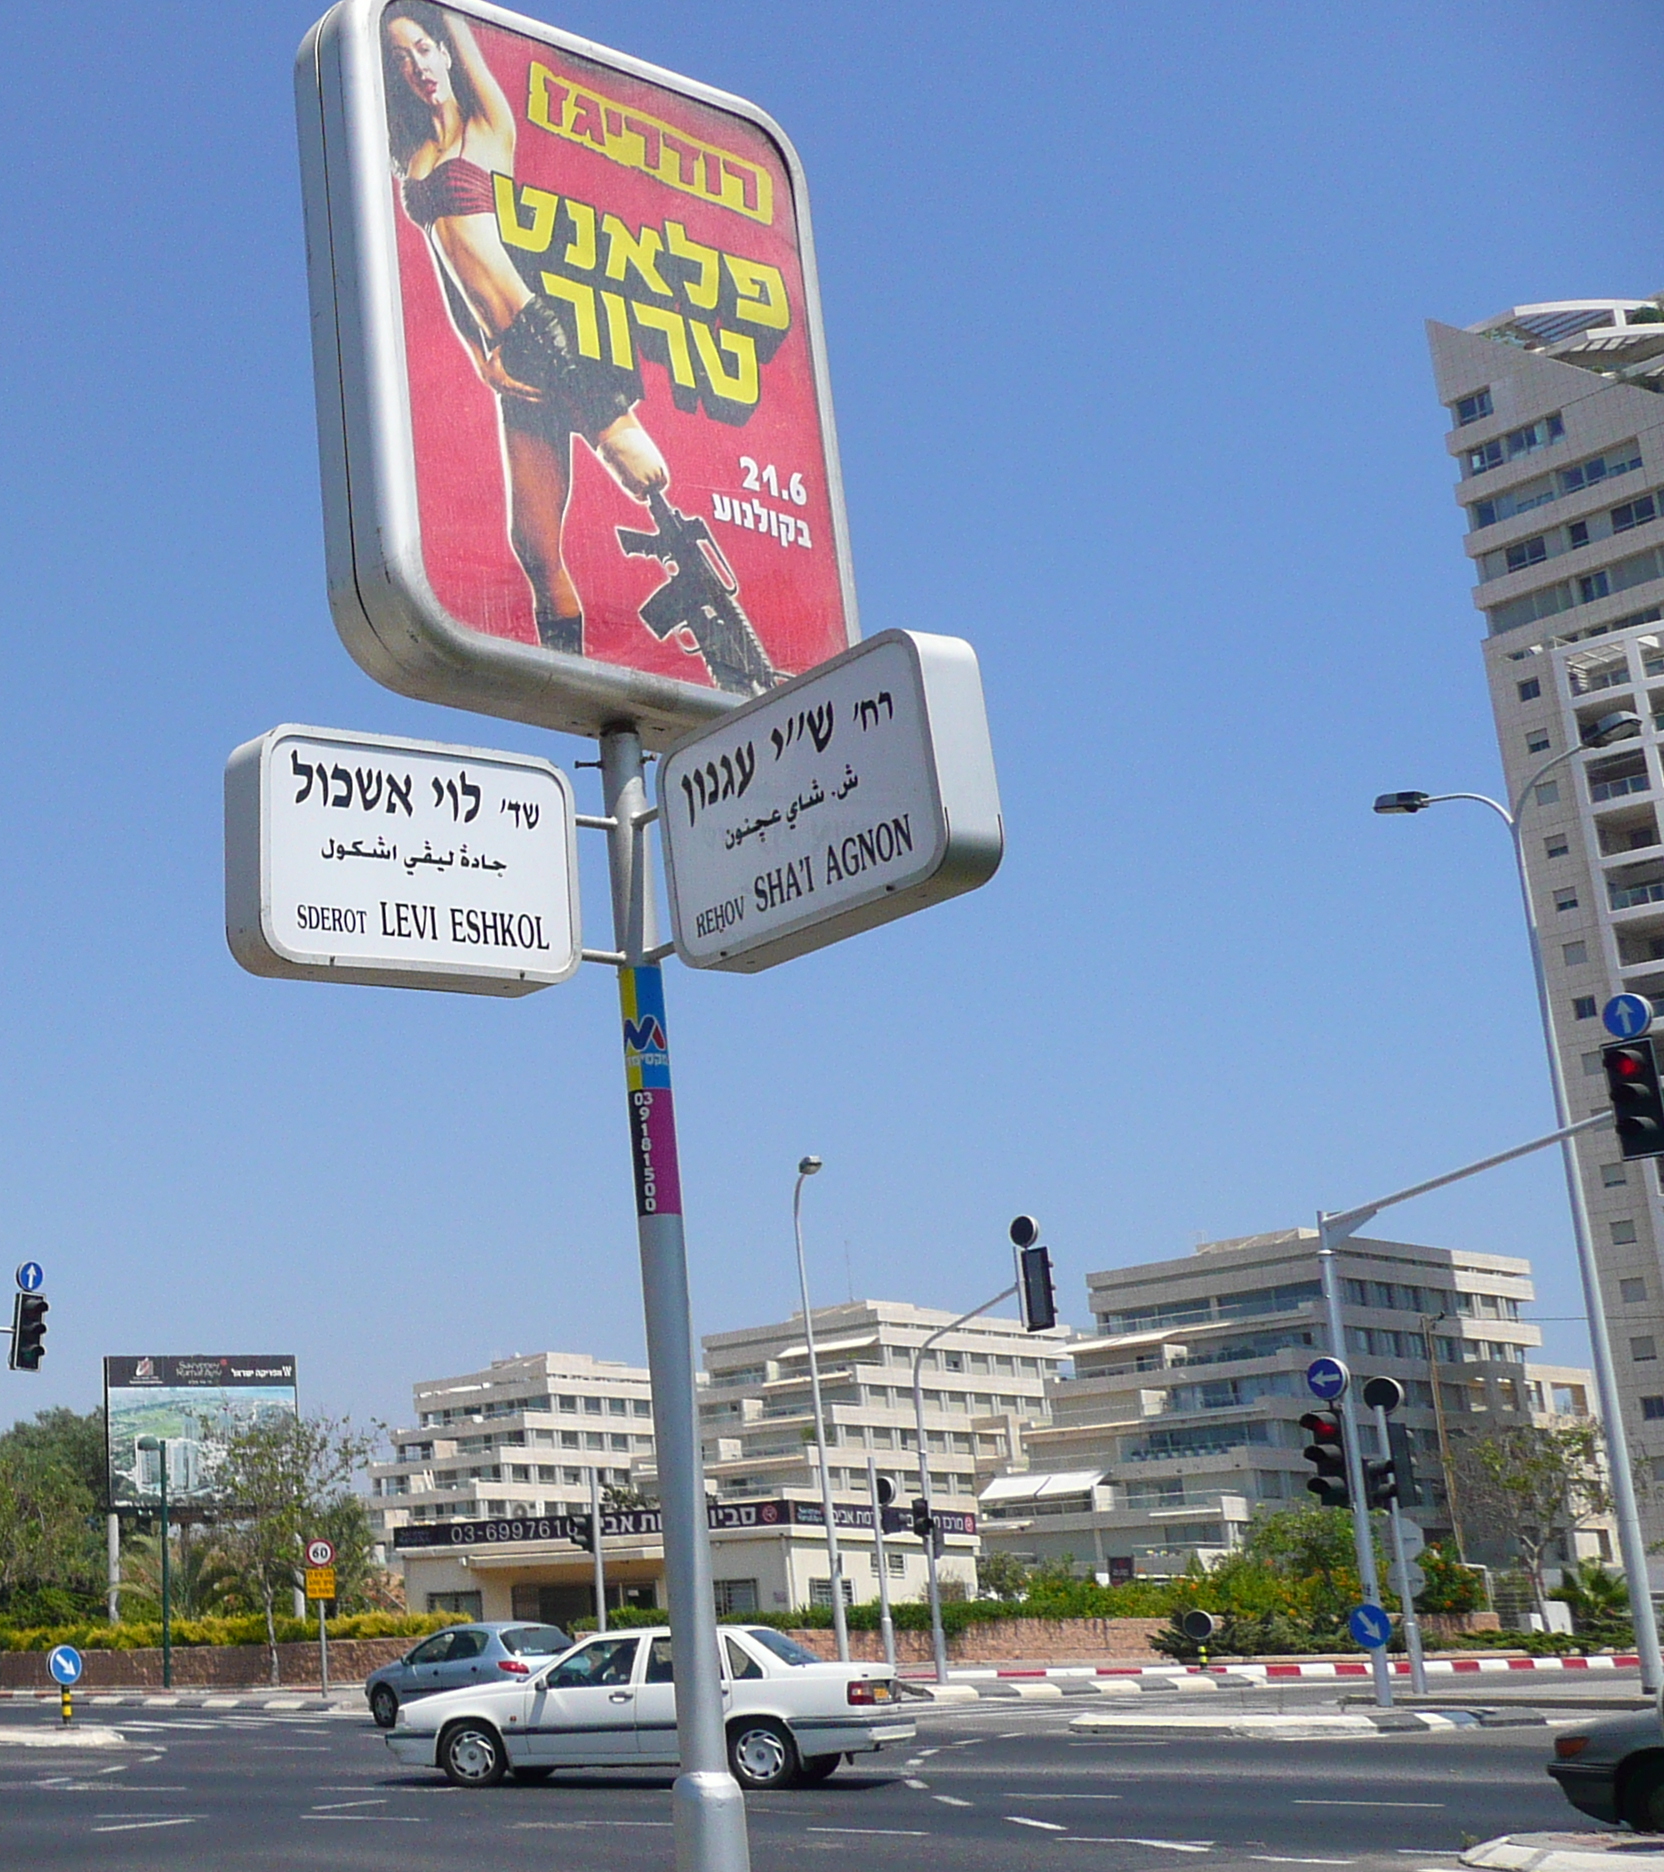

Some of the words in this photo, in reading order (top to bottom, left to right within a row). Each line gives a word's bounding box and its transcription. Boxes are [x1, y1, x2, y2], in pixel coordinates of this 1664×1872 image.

[541, 73, 761, 214] רודריגז
[491, 170, 790, 331] פלאנט
[540, 270, 760, 405] טרור
[739, 455, 808, 506] 21.6
[712, 493, 813, 549] בקולנוע
[291, 749, 414, 818] אשכול
[431, 770, 482, 824] לוי
[681, 740, 756, 828] עגנון
[785, 778, 825, 830] شاي
[461, 844, 507, 878] جادة
[754, 855, 815, 913] SHA'I
[826, 813, 914, 885] AGNON
[296, 903, 367, 934] SDEROT
[380, 901, 438, 941] LEVI
[450, 907, 550, 951] ESHKOL
[634, 1092, 653, 1106] 03
[599, 1515, 635, 1533] אבי
[709, 1506, 757, 1527] סביו
[856, 1510, 874, 1525] מת
[312, 1547, 328, 1559] 60
